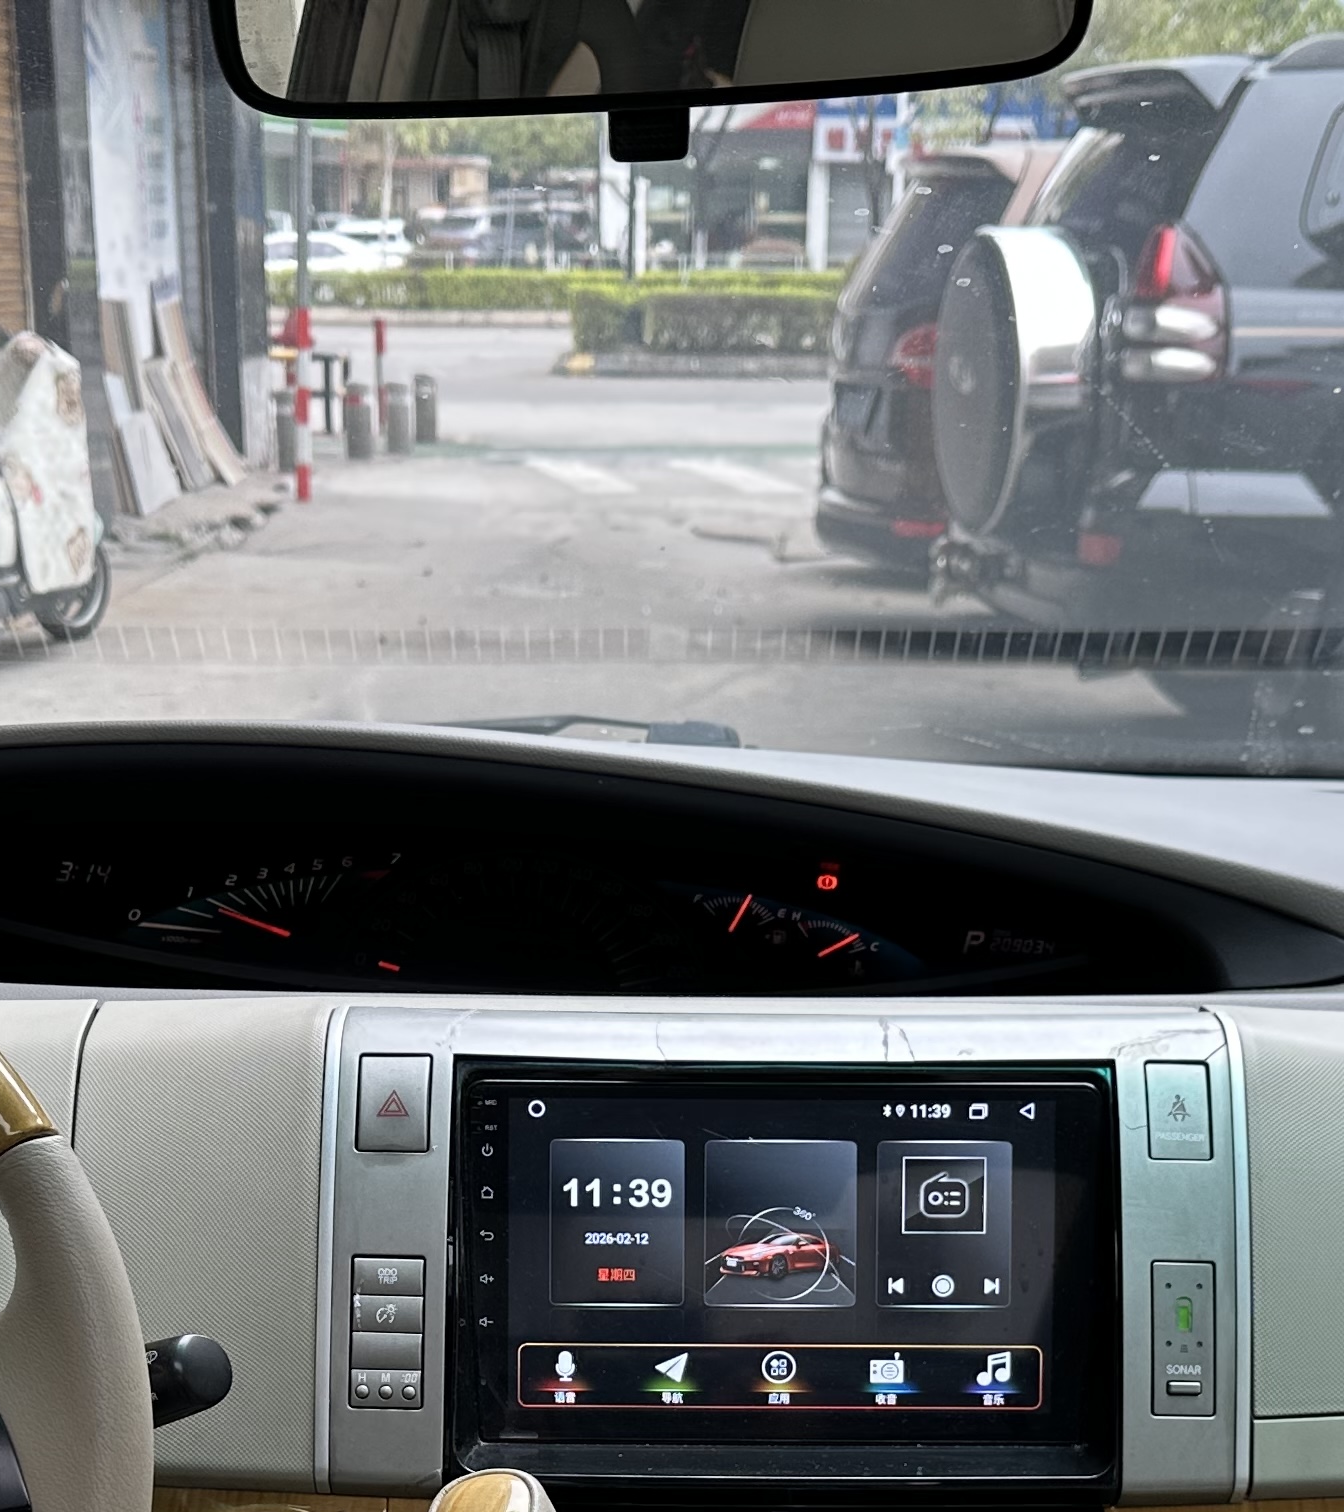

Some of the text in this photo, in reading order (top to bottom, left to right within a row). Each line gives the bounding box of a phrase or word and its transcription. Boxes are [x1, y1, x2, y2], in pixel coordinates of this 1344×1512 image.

[342, 856, 353, 868] 6
[390, 852, 402, 864] 7
[284, 862, 296, 874] 4
[311, 858, 324, 871] 5
[55, 861, 112, 884] 3:14
[256, 867, 269, 880] 3
[225, 874, 238, 887] 2
[187, 886, 194, 899] 1
[128, 908, 141, 922] 0
[777, 907, 787, 919] E
[791, 911, 802, 921] H
[869, 942, 880, 953] C
[962, 930, 987, 955] P
[989, 937, 1056, 955] 209034
[910, 1103, 951, 1118] 11:39
[562, 1178, 672, 1208] 11:39
[584, 1232, 649, 1245] 2026-02-12
[377, 1276, 398, 1284] TRIP
[597, 1268, 636, 1281] 星期四
[1166, 1364, 1202, 1375] SONAR
[358, 1372, 367, 1382] H
[381, 1372, 391, 1382] M
[554, 1391, 576, 1404] 语音
[661, 1392, 684, 1404] 导航
[768, 1393, 790, 1405] 应用
[875, 1393, 897, 1405] 收音
[982, 1394, 1005, 1406] 音乐
